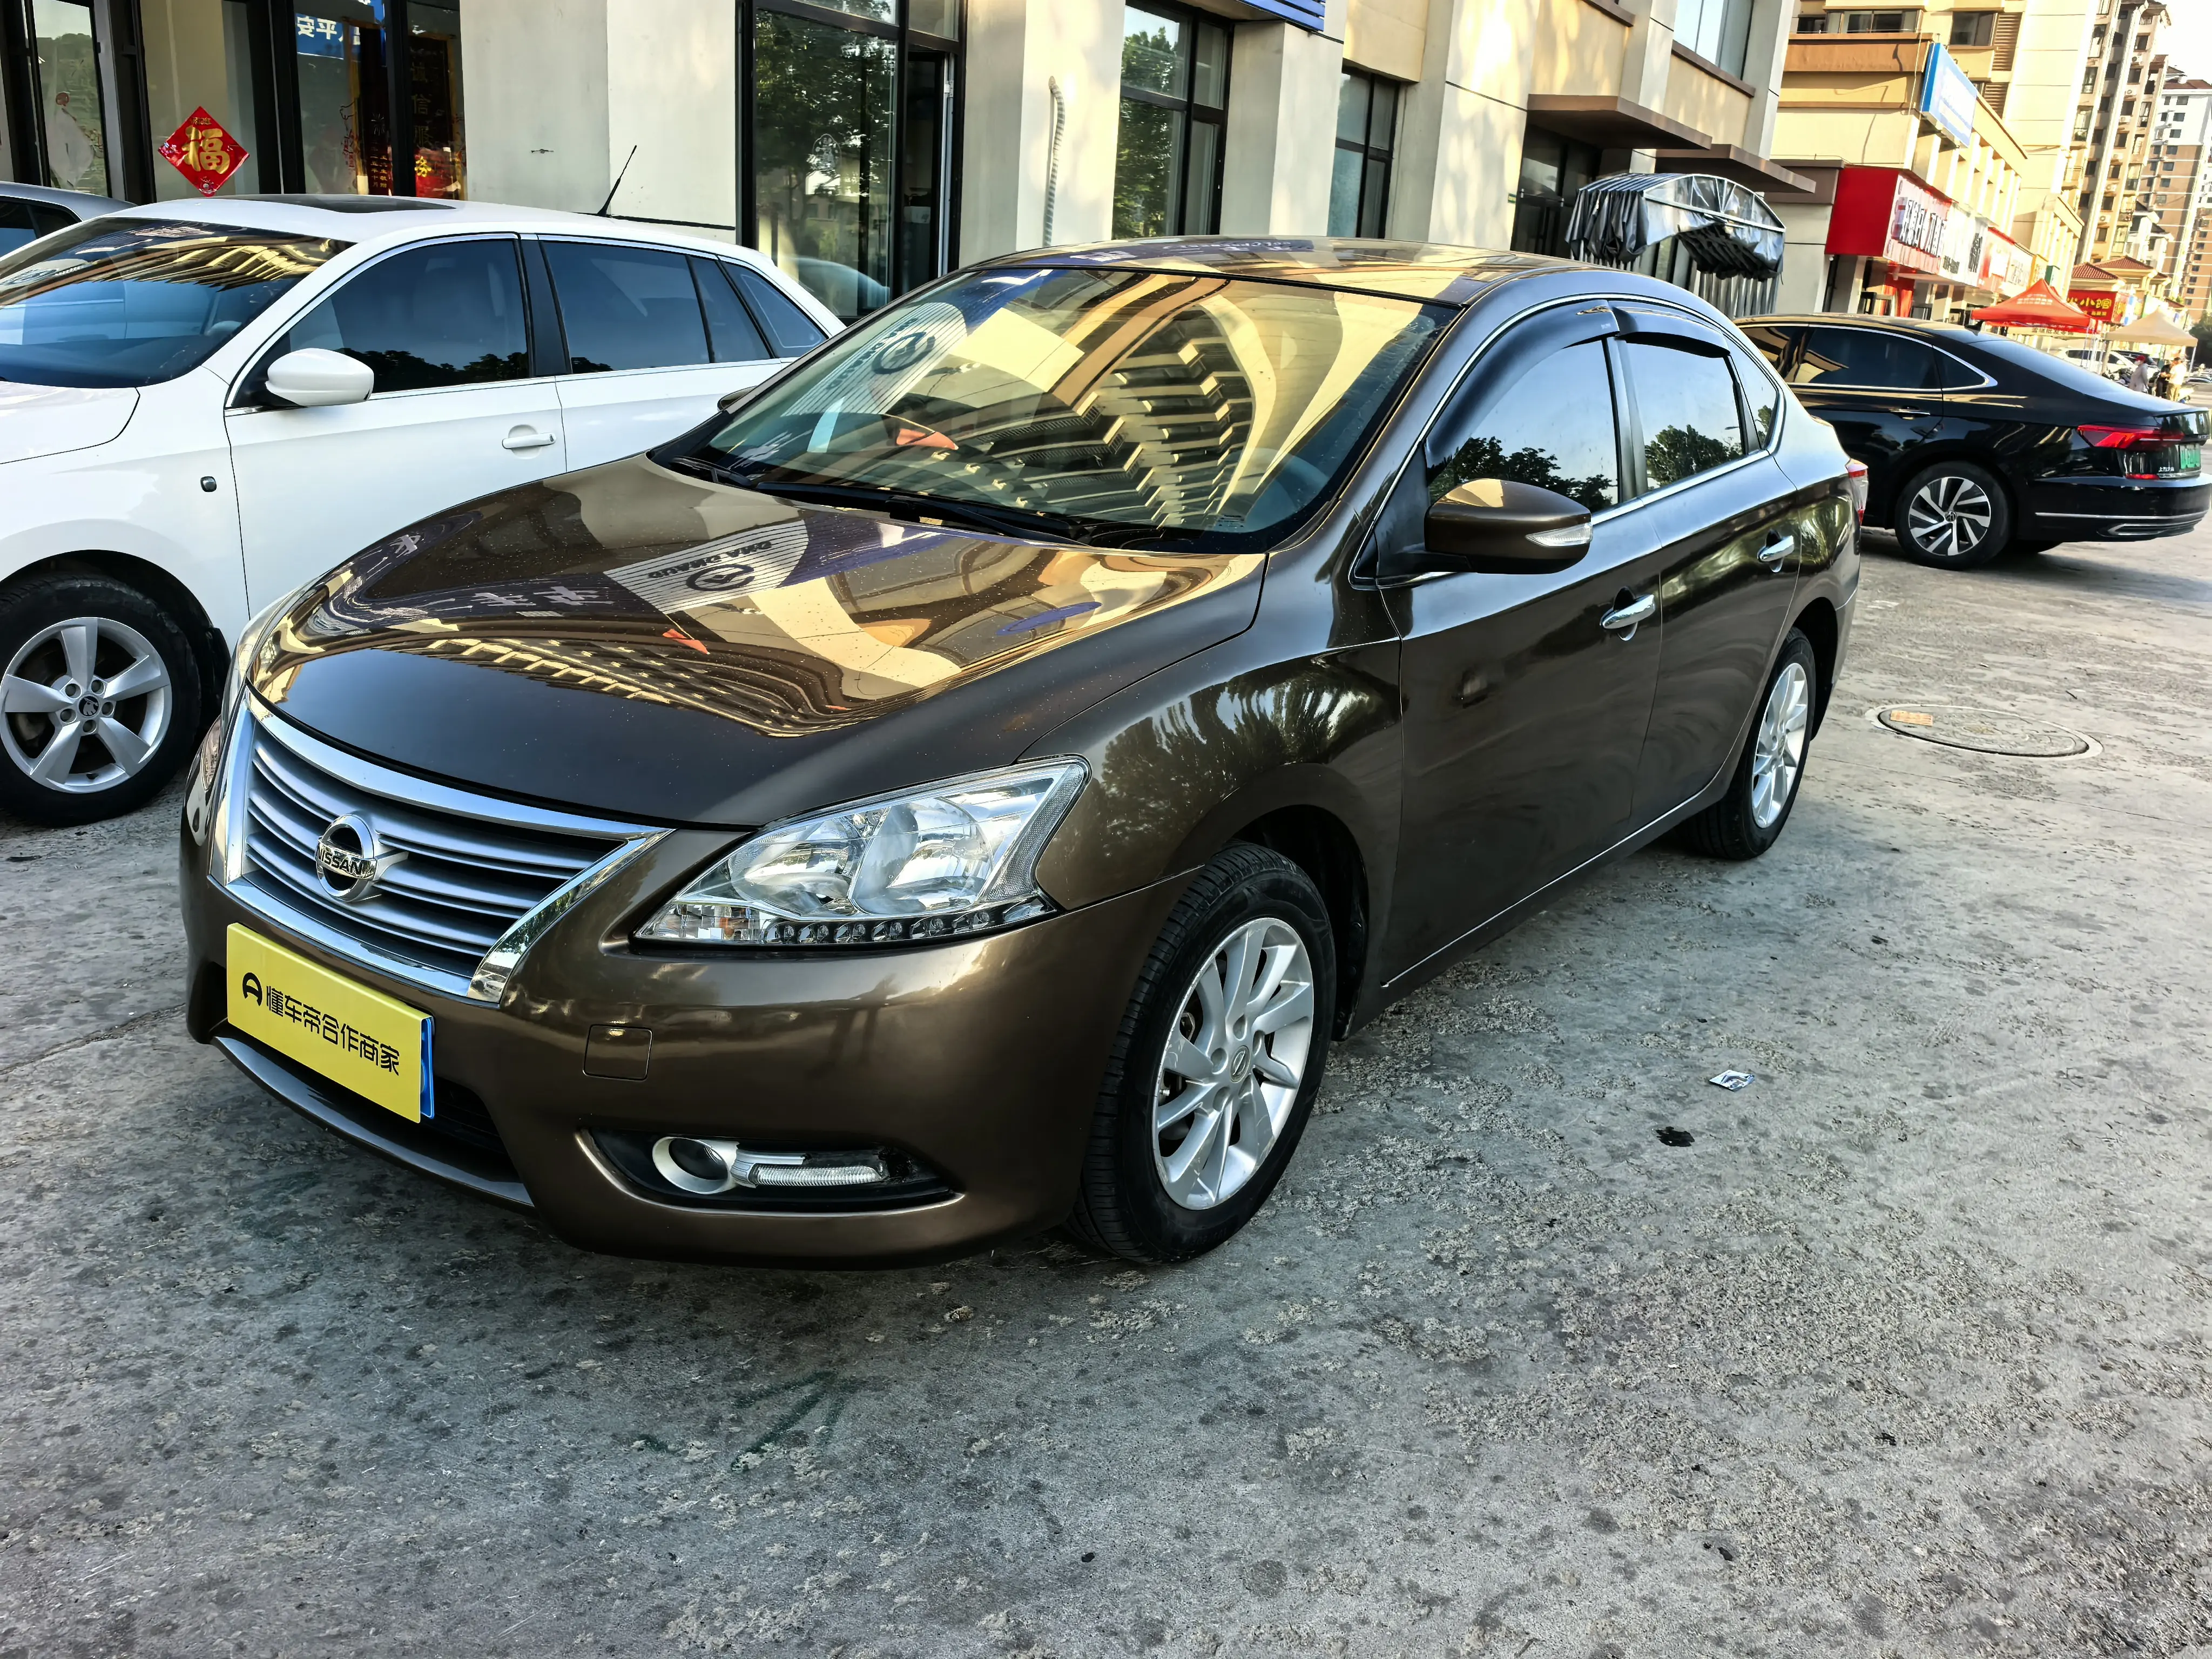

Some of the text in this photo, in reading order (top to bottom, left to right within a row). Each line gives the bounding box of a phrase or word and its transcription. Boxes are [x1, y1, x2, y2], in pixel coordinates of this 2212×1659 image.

[181, 126, 230, 174] 福
[318, 843, 362, 875] NISSAN
[266, 985, 400, 1077] 懂车帝合作商家
